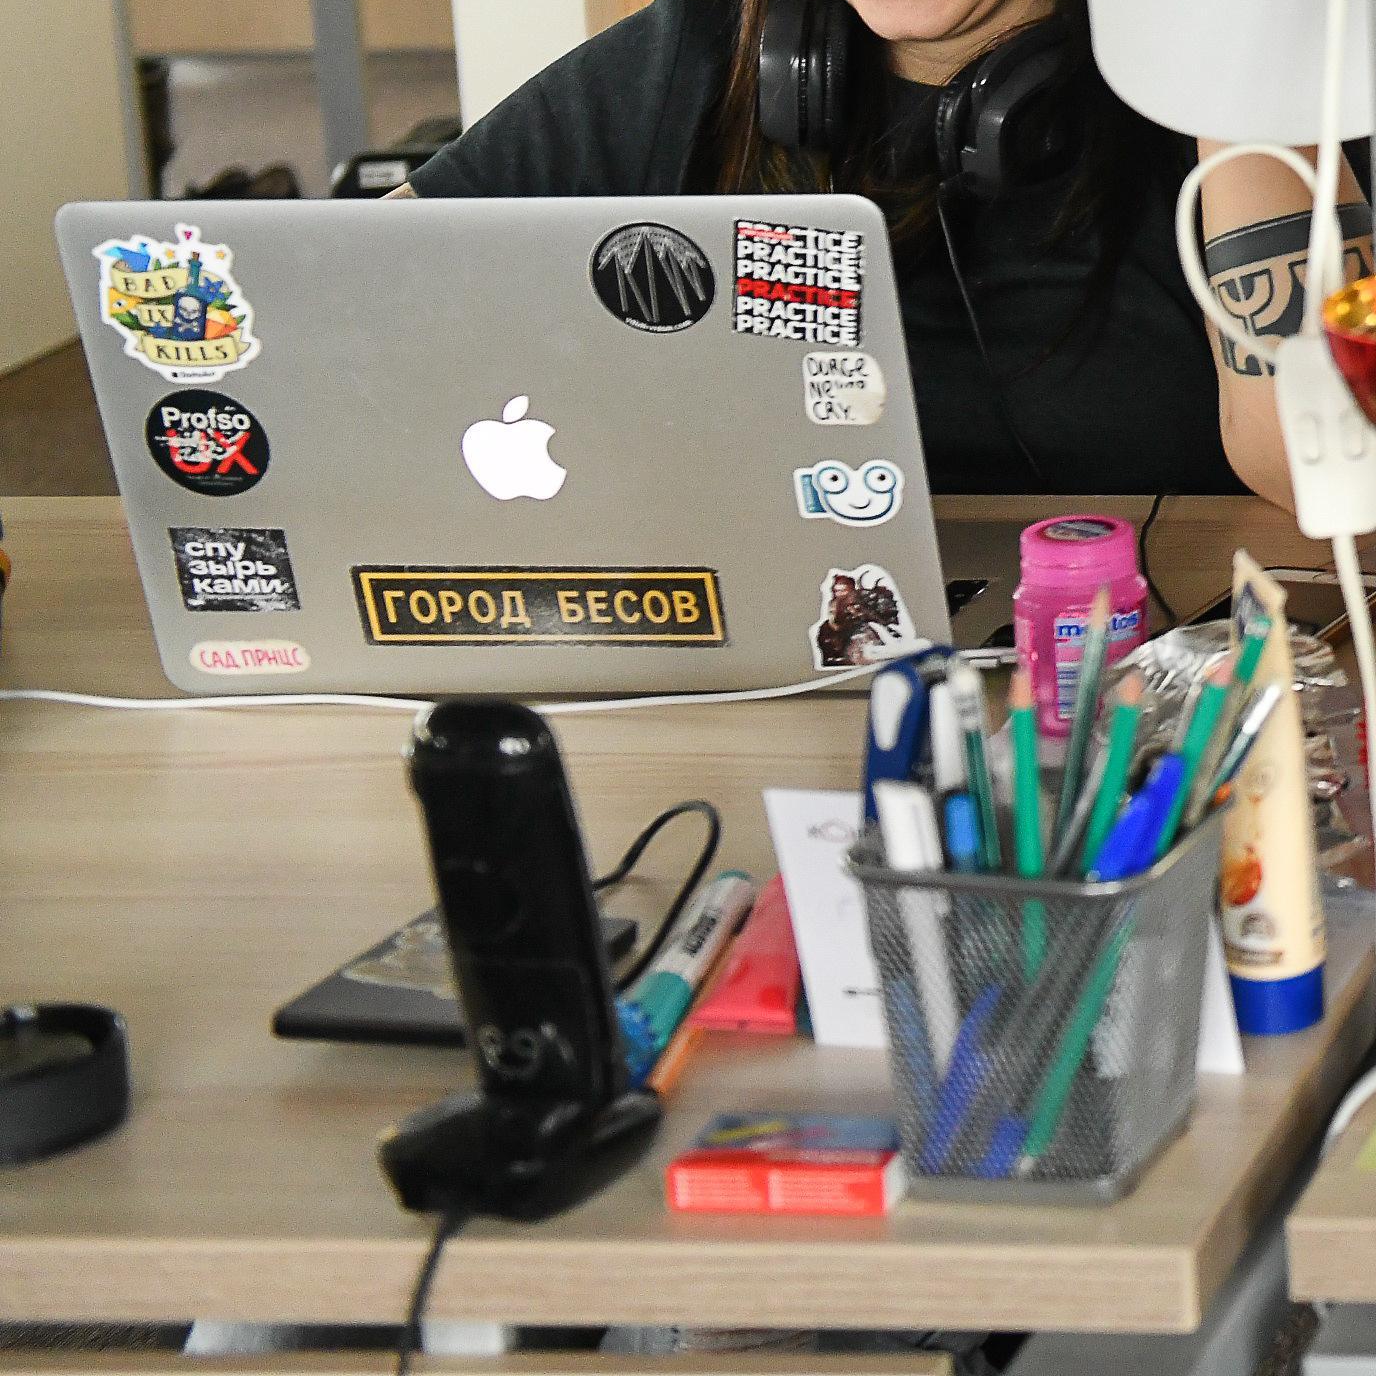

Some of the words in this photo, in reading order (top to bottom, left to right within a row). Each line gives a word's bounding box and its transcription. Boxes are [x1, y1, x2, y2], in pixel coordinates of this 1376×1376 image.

[737, 221, 860, 253] PRACTICE
[737, 240, 860, 272] PRACTICE
[123, 276, 177, 293] BAD
[737, 259, 860, 291] PRACTICE
[737, 278, 860, 309] PRACTICE
[737, 296, 860, 327] PRACTICE
[737, 314, 860, 347] PRACTICE
[155, 345, 229, 361] KILLS
[161, 406, 252, 431] Profso
[184, 541, 246, 562] спу
[188, 559, 278, 580] зырь
[191, 577, 289, 594] ками
[382, 589, 532, 629] ГОРОД
[555, 589, 701, 624] БЕСОВ
[200, 650, 241, 670] САД
